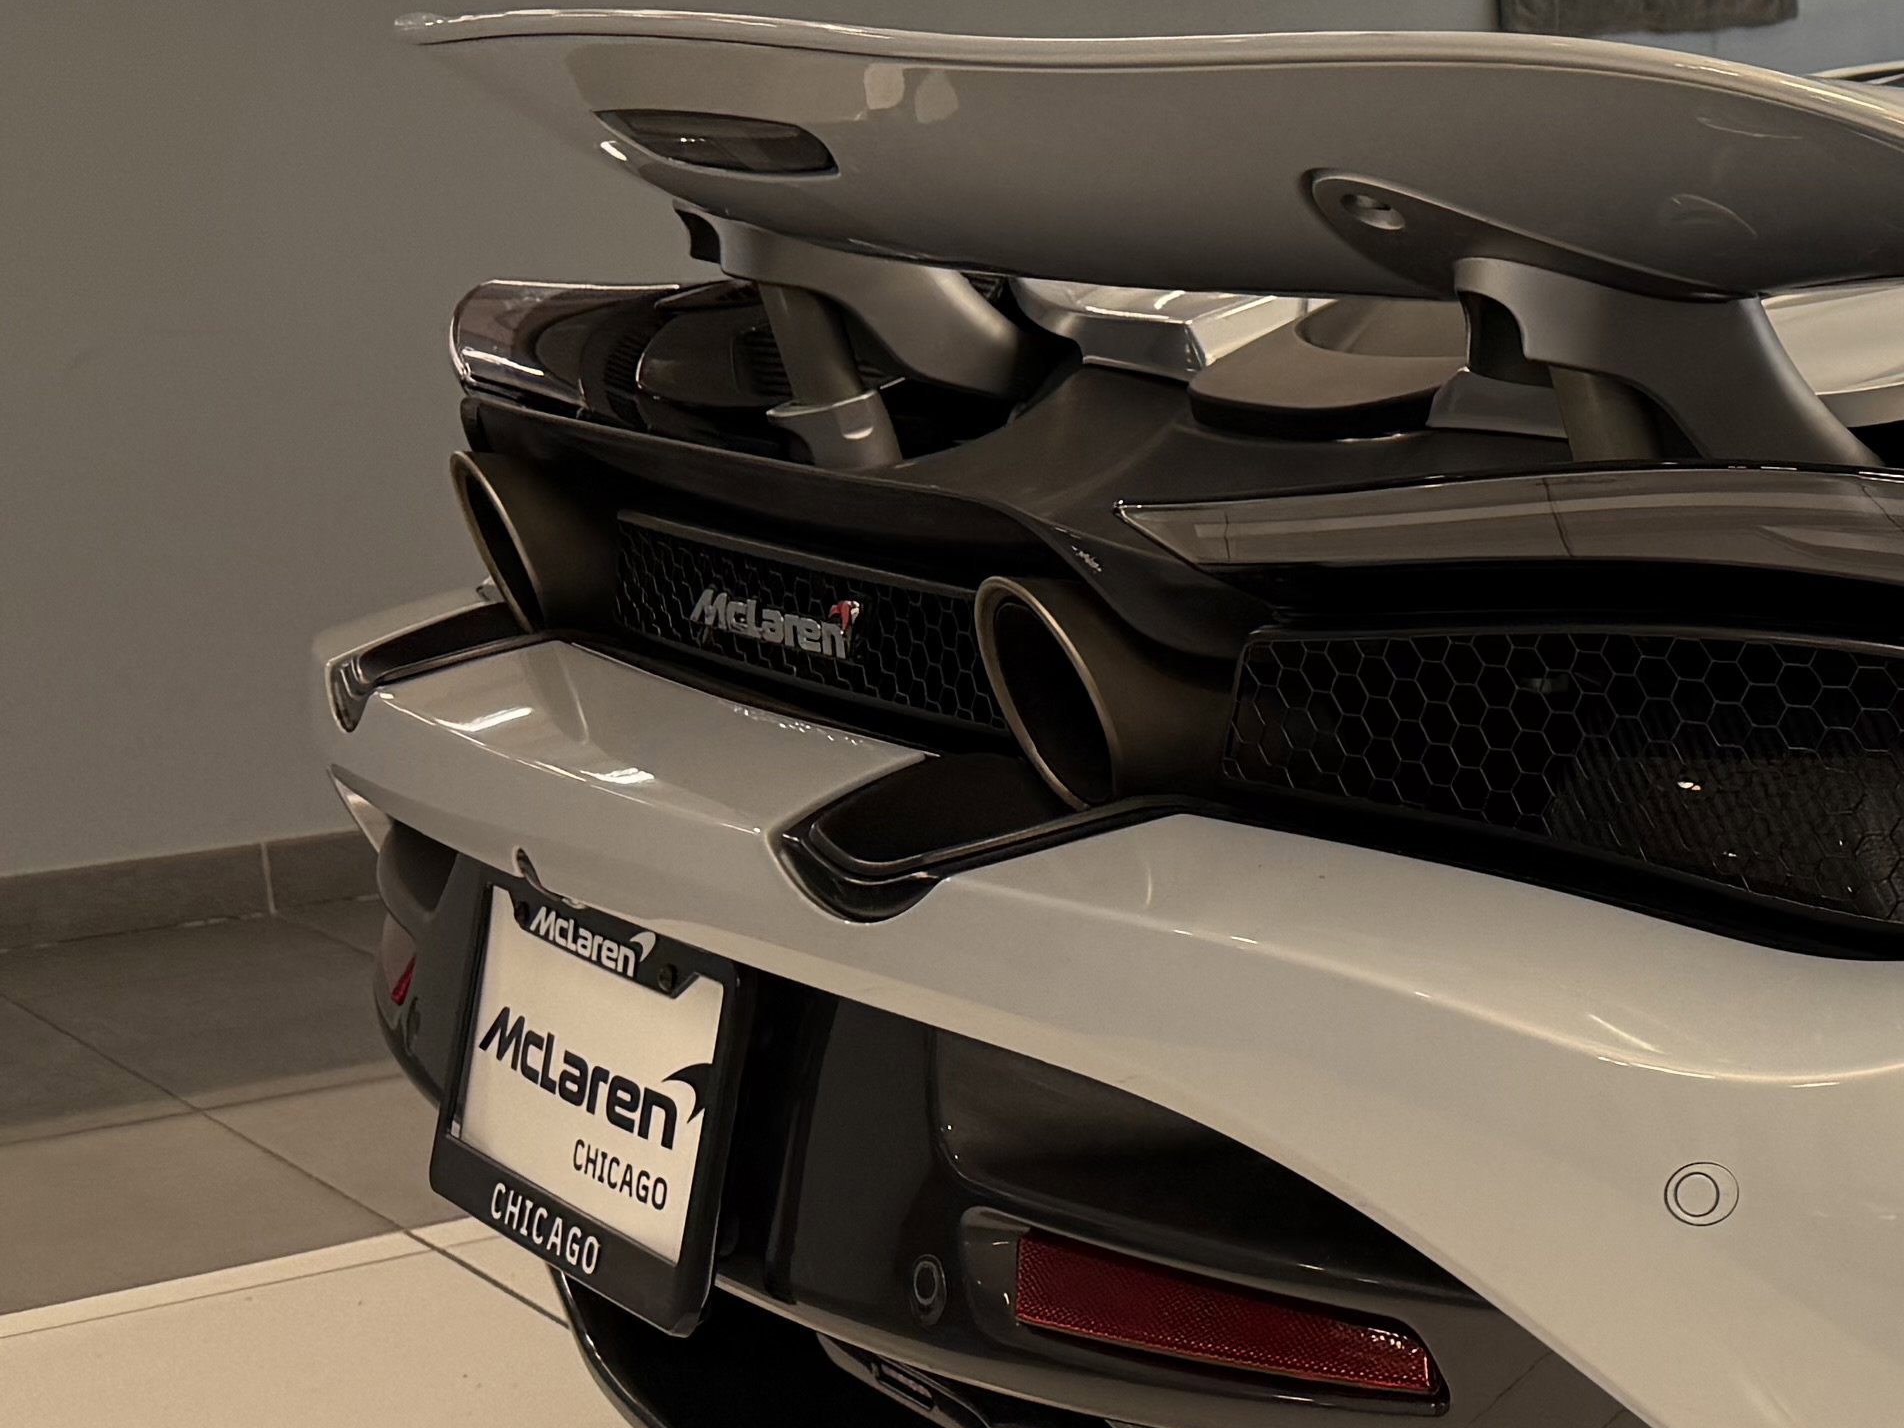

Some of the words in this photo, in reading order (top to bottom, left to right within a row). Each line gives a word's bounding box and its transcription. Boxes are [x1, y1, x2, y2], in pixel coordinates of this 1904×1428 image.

[690, 587, 849, 660] McLaren
[528, 906, 638, 977] McLaren
[478, 1006, 679, 1151] McLaren
[573, 1138, 669, 1211] CHICAGO
[491, 1181, 602, 1276] CHICAGO
